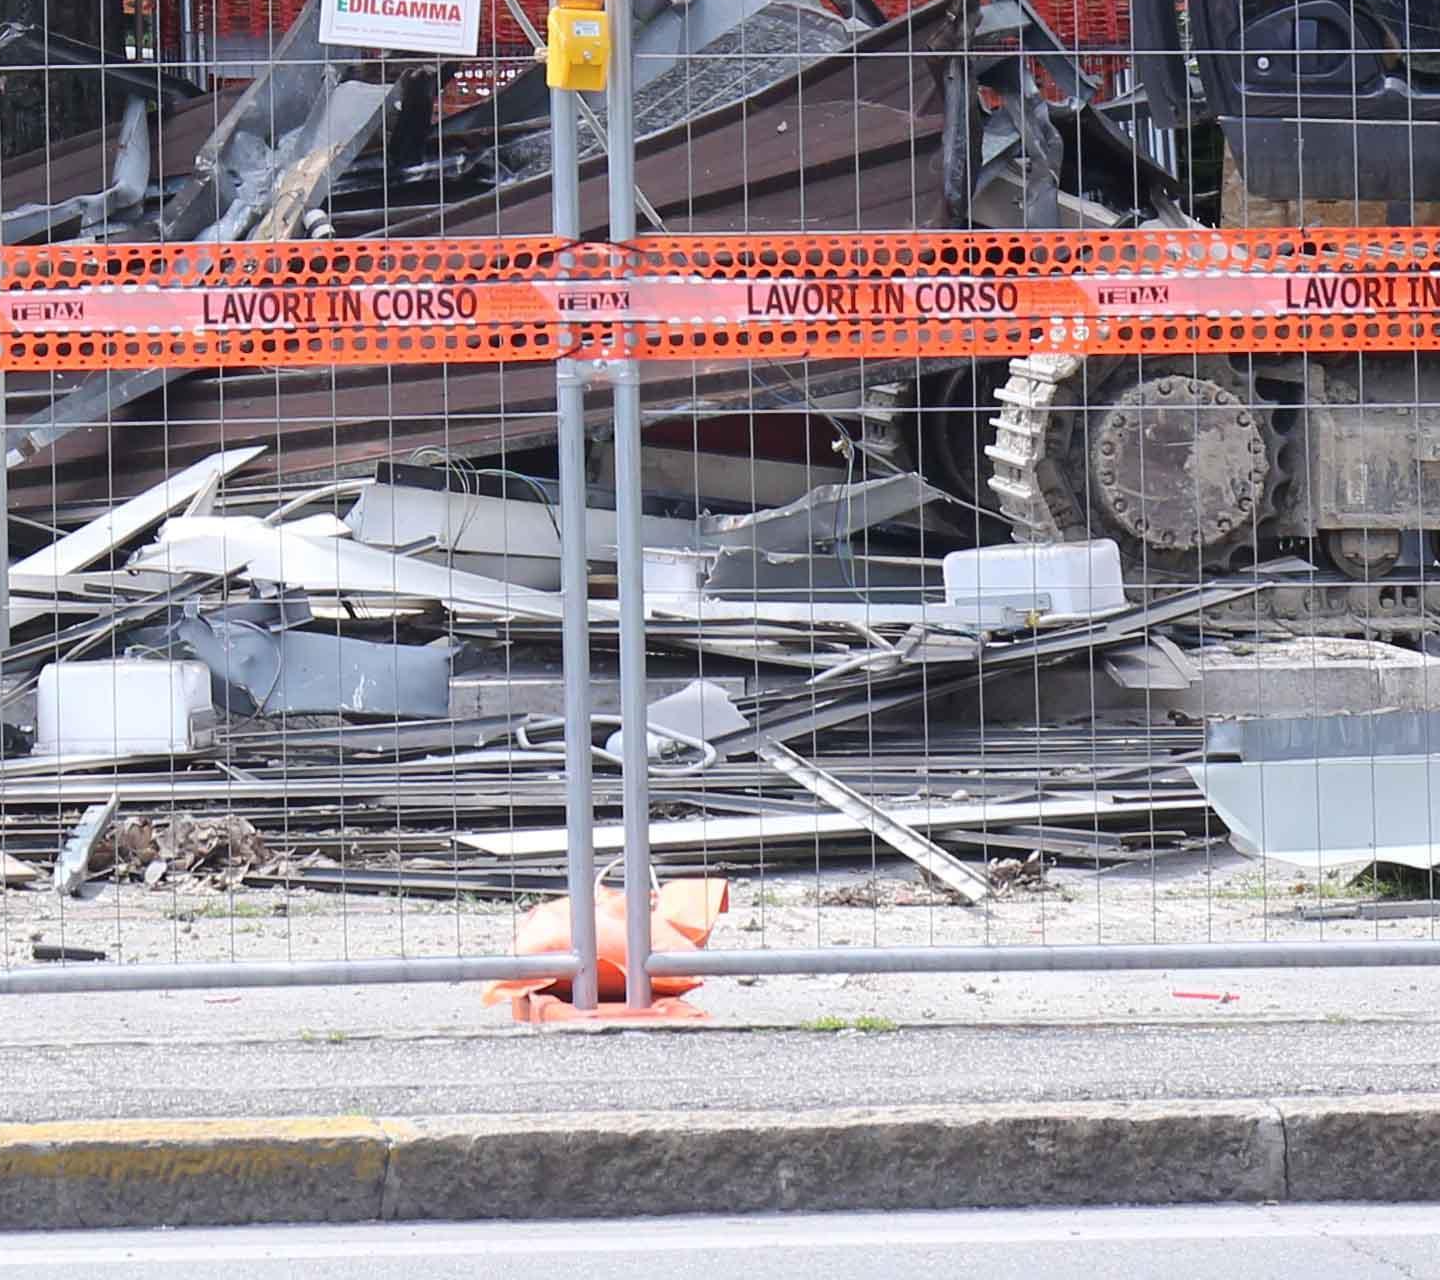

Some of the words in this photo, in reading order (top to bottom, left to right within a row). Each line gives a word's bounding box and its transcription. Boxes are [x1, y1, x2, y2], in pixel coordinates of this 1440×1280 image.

[559, 291, 629, 311] TENAX
[747, 282, 860, 315] LAVORI
[871, 282, 905, 314] IN
[915, 281, 1019, 314] CORSO
[1098, 285, 1168, 305] TENAX
[1285, 275, 1398, 308] LAVORI
[12, 301, 83, 321] TENAX
[203, 291, 316, 325] LAVORI
[327, 290, 362, 322] IN
[372, 287, 478, 320] CORSO
